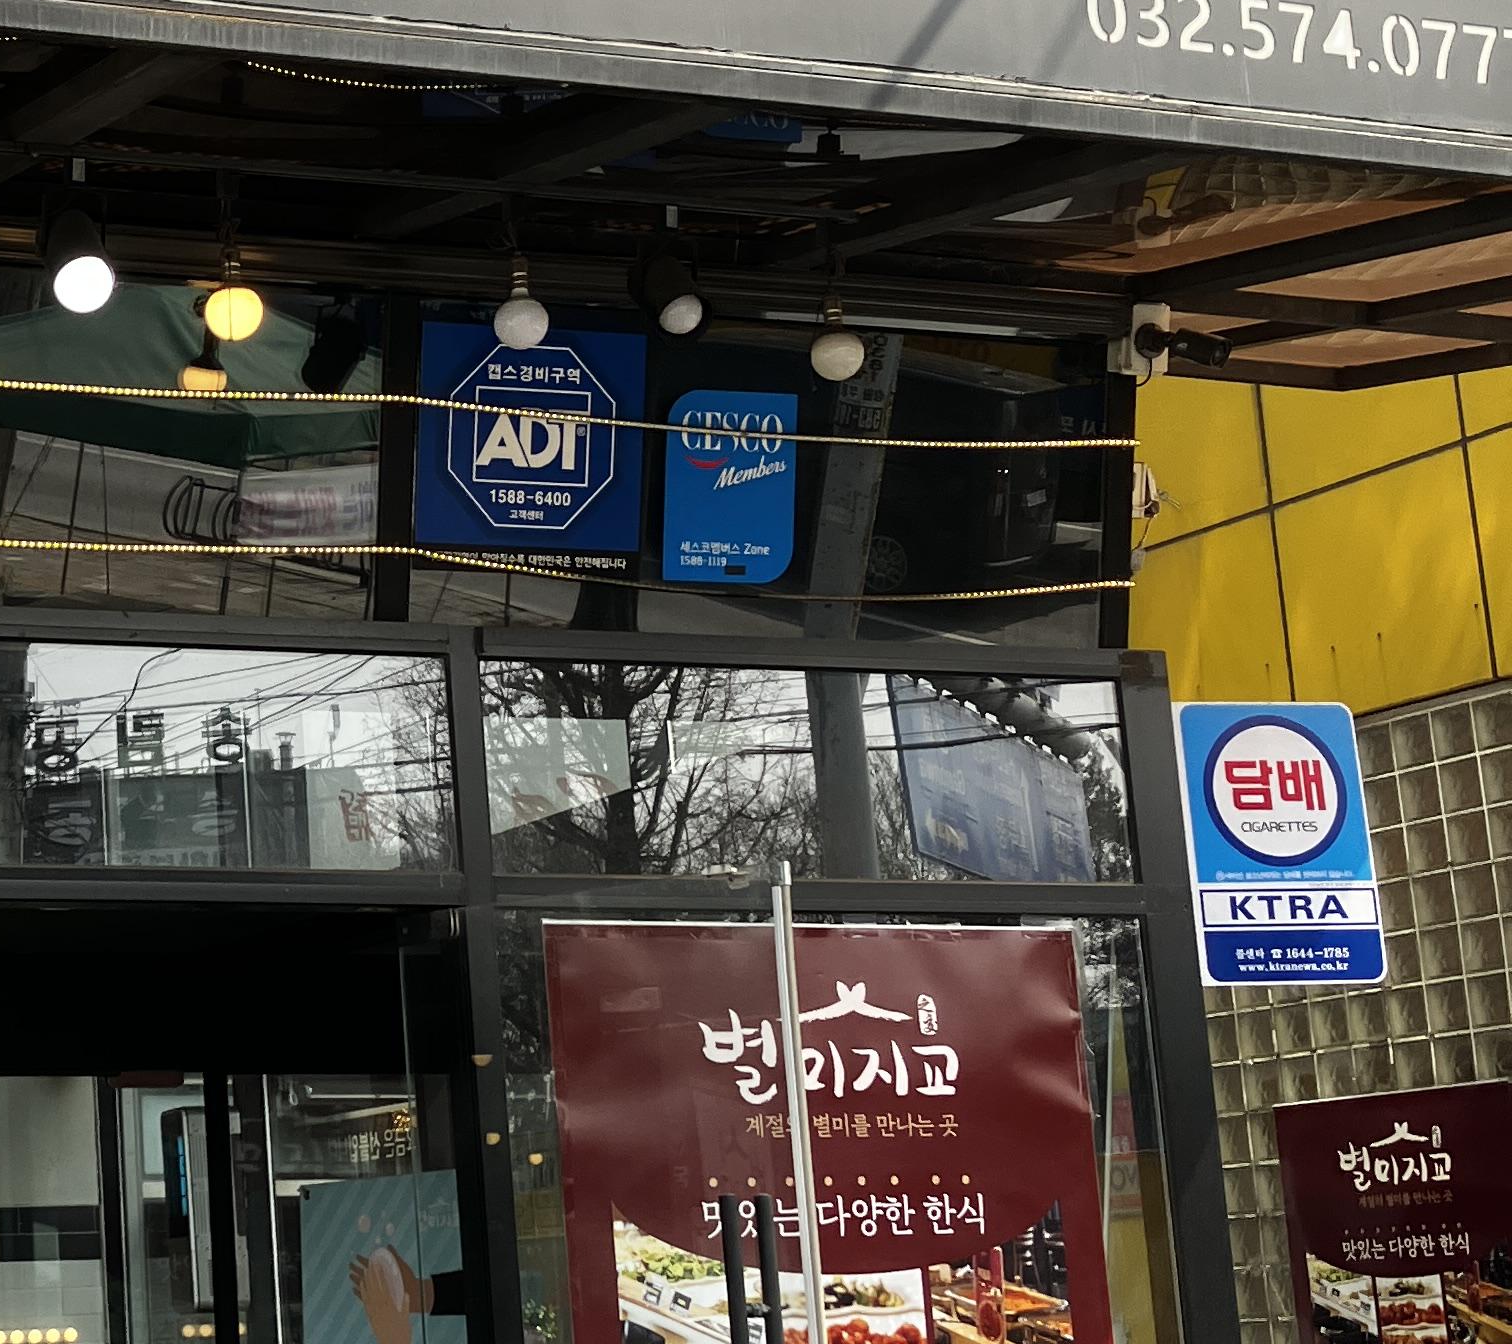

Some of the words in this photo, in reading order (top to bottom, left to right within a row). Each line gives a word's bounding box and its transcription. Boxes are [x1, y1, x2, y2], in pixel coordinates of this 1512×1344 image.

[488, 363, 581, 385] 캡스경비구역
[476, 406, 589, 470] ADT
[681, 410, 784, 453] CESCO
[713, 455, 787, 490] Members
[489, 489, 571, 506] 1588-6400
[743, 543, 771, 556] Zone
[1224, 760, 1326, 811] 담배
[1241, 821, 1318, 833] CIGARETTES
[1229, 894, 1349, 920] KTRA
[1286, 947, 1350, 959] 1644-1785
[697, 1008, 959, 1105] 별미지교
[813, 1113, 871, 1138] 별미를
[876, 1112, 934, 1138] 만나는
[938, 1113, 959, 1138] 곳
[1337, 1141, 1451, 1192] 별미지교
[815, 1194, 915, 1237] 다양한
[923, 1192, 985, 1236] 한식
[1342, 1238, 1386, 1261] 맛있는
[1389, 1234, 1435, 1259] 다양한
[1438, 1231, 1470, 1256] 한식
